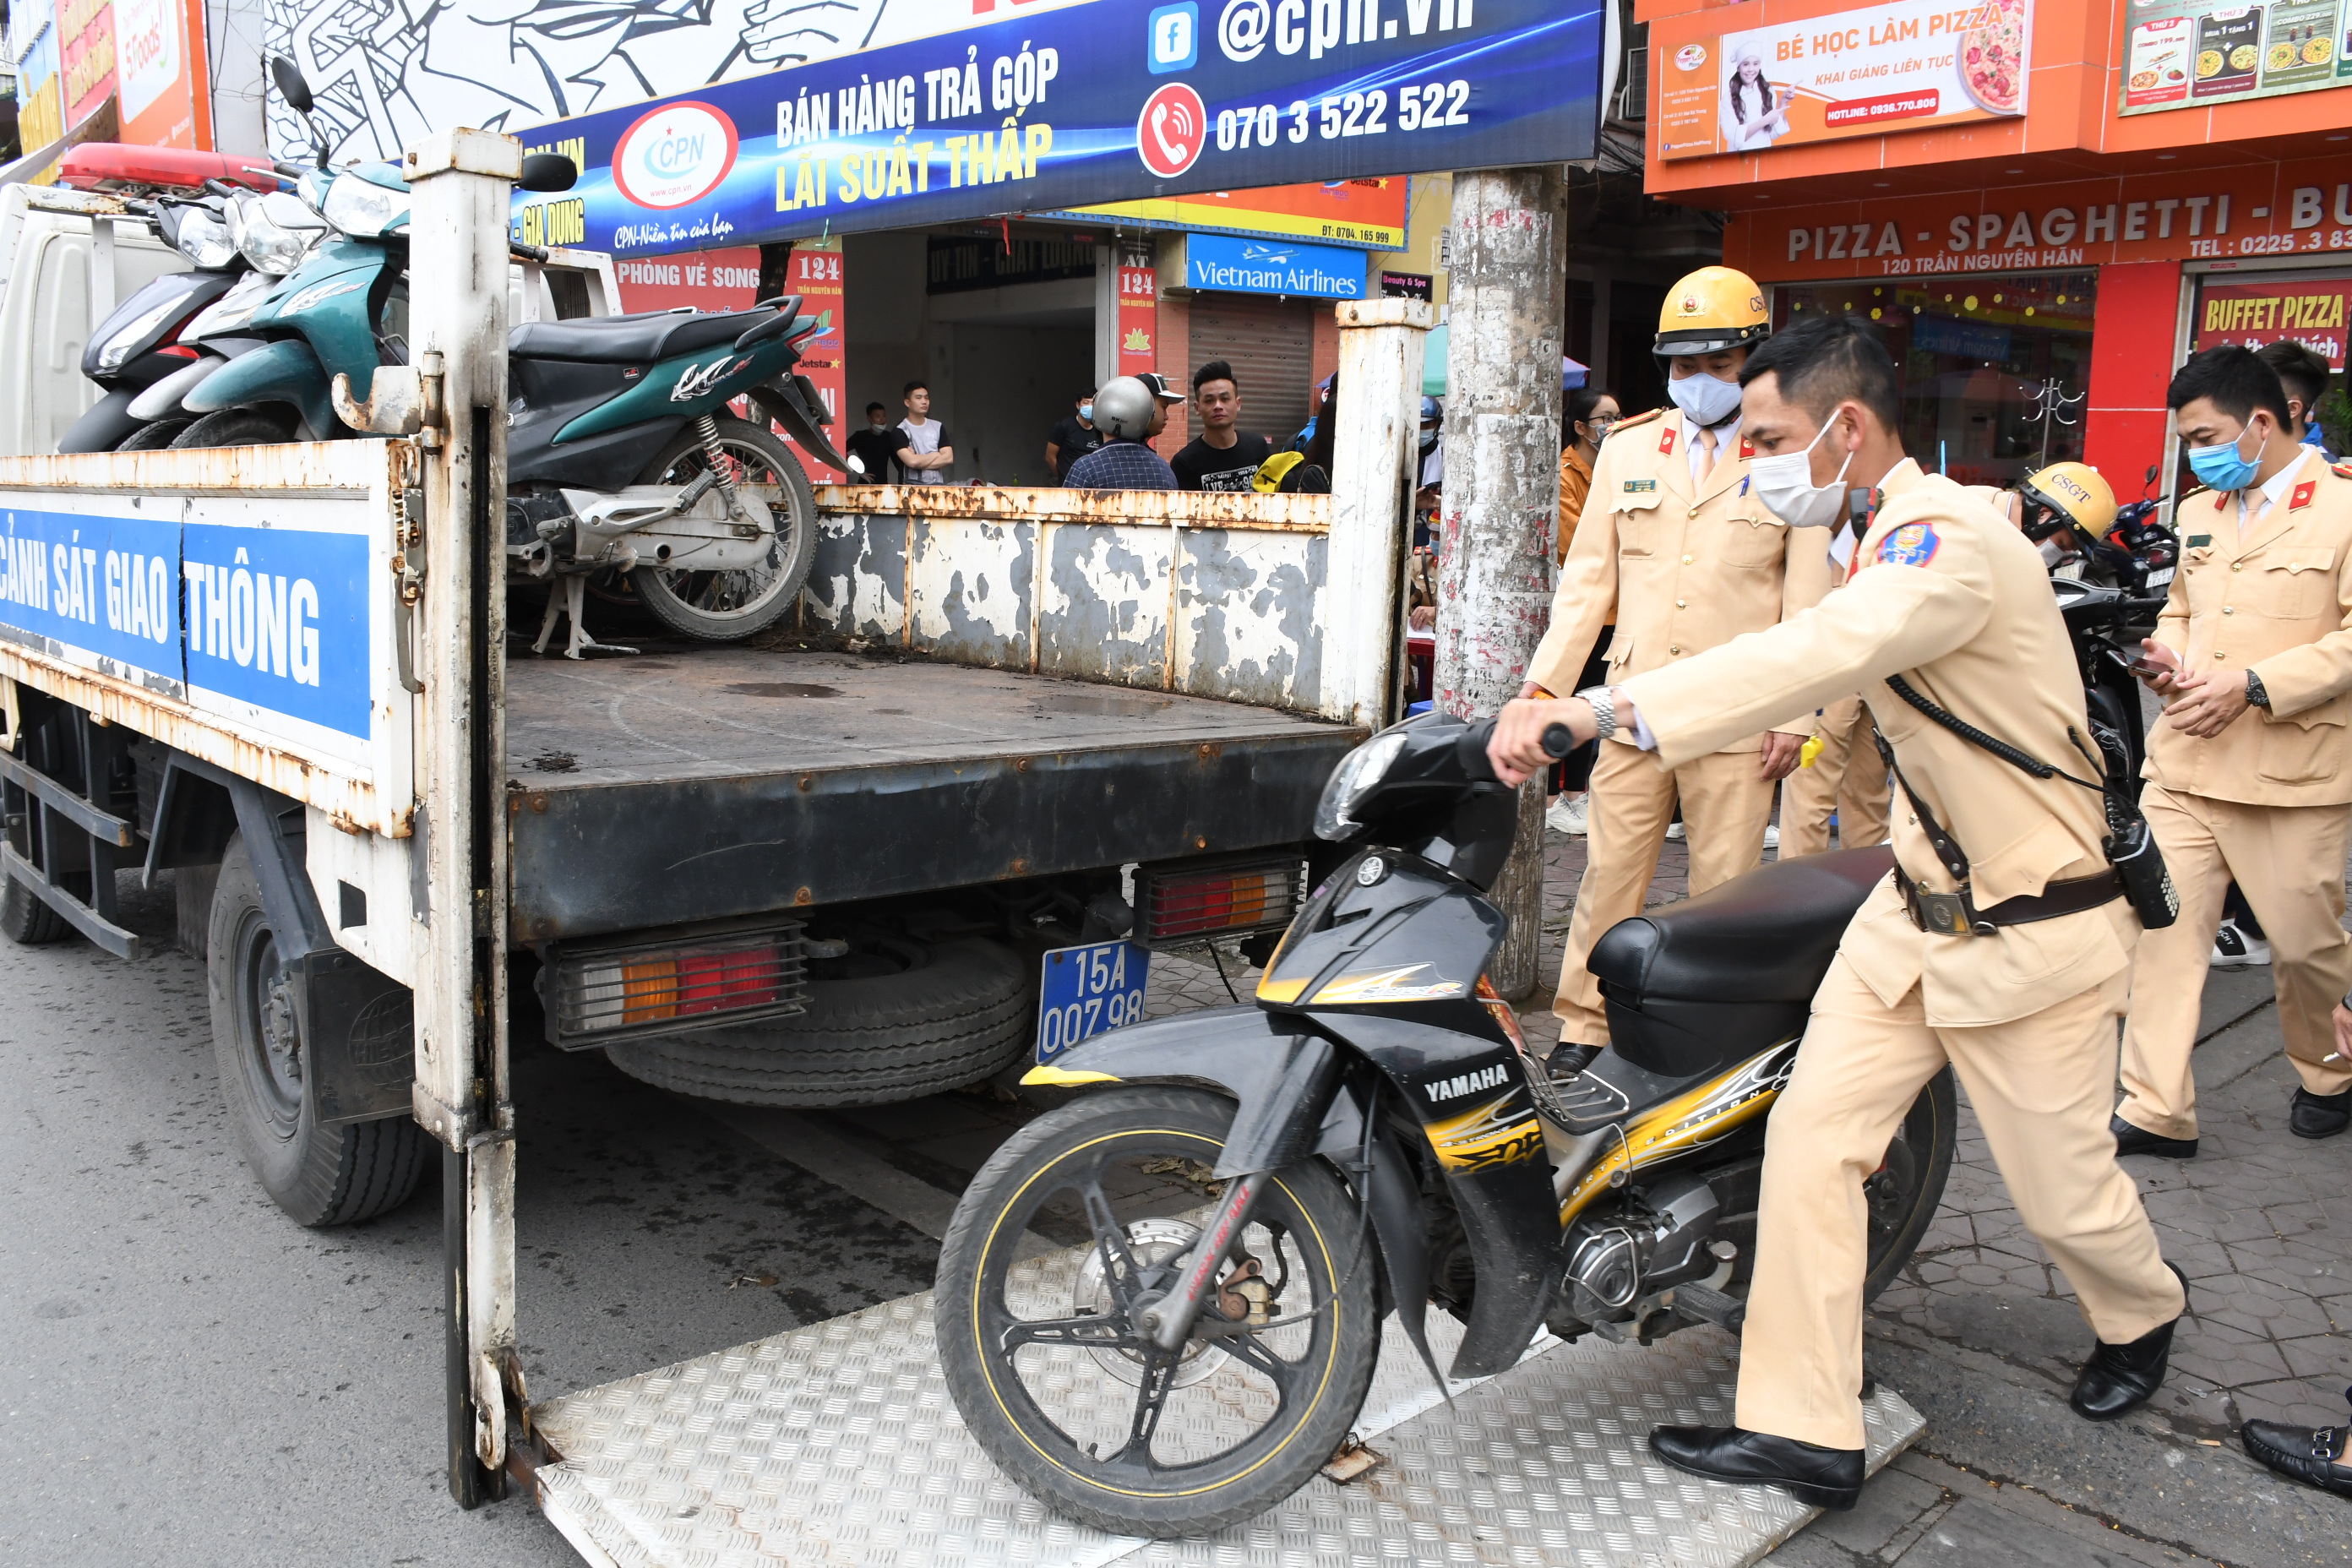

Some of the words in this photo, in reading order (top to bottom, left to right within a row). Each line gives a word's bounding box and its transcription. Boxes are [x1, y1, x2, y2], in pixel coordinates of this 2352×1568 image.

[1777, 33, 1804, 62] BÉ
[1813, 29, 1859, 58] HỌC
[1869, 17, 1919, 46] LÀM
[1929, 4, 2003, 36] PIZZA
[2221, 26, 2227, 35] 1
[2248, 22, 2253, 30] 1
[2277, 15, 2305, 25] COMBO
[1815, 73, 1845, 85] KHAI
[1849, 64, 1888, 81] GIẢNG
[1893, 57, 1921, 74] LIÊN
[1928, 54, 1954, 72] TỤC
[777, 86, 830, 148] BÁN
[839, 74, 915, 137] HÀNG
[924, 45, 982, 122] TRẢ
[993, 40, 1058, 111] GÓP
[1827, 106, 1868, 121] HOTLINE:
[1870, 98, 1936, 116] 0936.770.806
[1217, 105, 1277, 151] 070
[1288, 101, 1309, 144] 3
[1320, 90, 1387, 139] 522
[1399, 80, 1470, 131] 522
[660, 133, 705, 169] CPN
[776, 151, 826, 211] LÃI
[839, 126, 933, 203] SUẤT
[946, 107, 1052, 188] THẤP
[651, 183, 692, 198] www.cpn.vn
[522, 204, 545, 246] GIA
[670, 222, 688, 241] tin
[690, 219, 709, 237] của
[713, 213, 733, 241] bạn
[1322, 225, 1334, 237] ĐT:
[1337, 226, 1357, 239] 0704.
[1360, 230, 1373, 242] 165
[1376, 232, 1389, 242] 999
[1788, 221, 1903, 262] PIZZA
[1947, 194, 2230, 252] SPAGHETTI
[1883, 259, 1910, 275] 120
[1914, 251, 1958, 273] TRẦN
[1963, 248, 2036, 270] NGUYÊN
[2042, 246, 2082, 266] HÃN
[2190, 240, 2220, 257] TEL
[2240, 234, 2295, 253] 0225
[618, 259, 680, 286] PHÒNG
[685, 263, 707, 286] VÉ
[712, 267, 760, 289] SONG
[799, 257, 840, 280] 124
[1122, 273, 1153, 295] 124
[1195, 260, 1282, 289] Vietnam
[1285, 268, 1357, 295] Airlines
[1383, 275, 1406, 287] Beauty
[1414, 278, 1426, 288] Spa
[2205, 297, 2281, 332] BUFFET
[2281, 294, 2344, 329] PIZZA
[799, 359, 831, 368] Jetstar
[2051, 472, 2092, 504] CSGT
[53, 529, 96, 625] SÁT
[105, 549, 169, 645] GIAO
[182, 547, 320, 688] THÔNG
[1076, 945, 1124, 997] 15A
[1424, 1064, 1510, 1102] YAMAHA
